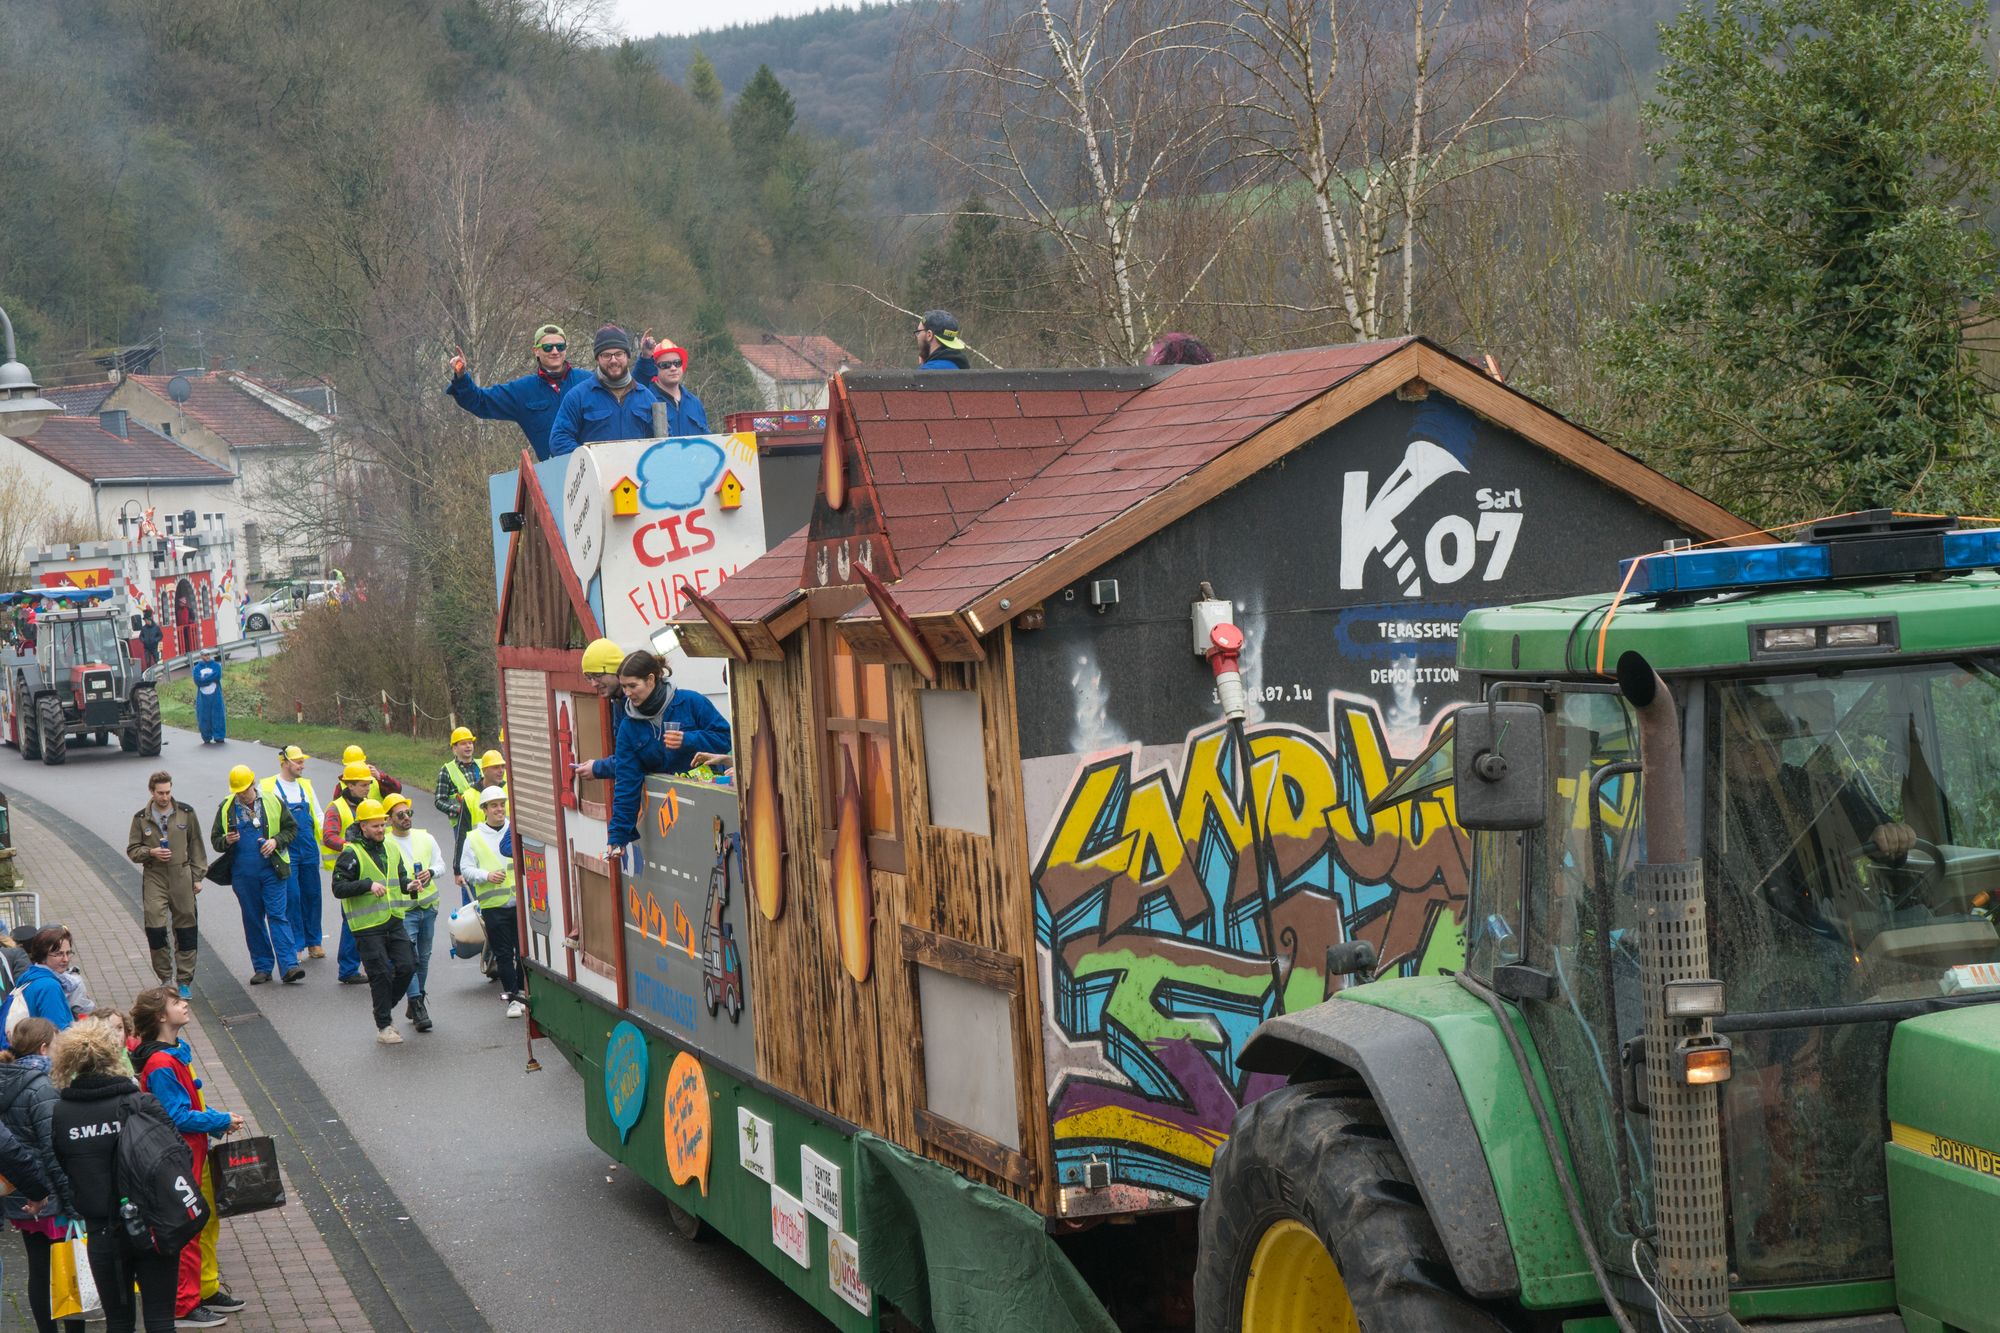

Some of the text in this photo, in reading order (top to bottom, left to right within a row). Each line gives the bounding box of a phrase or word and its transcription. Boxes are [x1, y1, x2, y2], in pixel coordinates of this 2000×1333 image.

[632, 507, 716, 568] CIS
[1377, 621, 1462, 639] TERASSEME
[1370, 666, 1460, 685] DEMOLITION
[1211, 684, 1313, 705] io@k07.lu
[1931, 1136, 1977, 1169] JOHN
[814, 1164, 832, 1186] CENTRE
[815, 1180, 821, 1196] DE
[820, 1185, 838, 1208] LAVAGE
